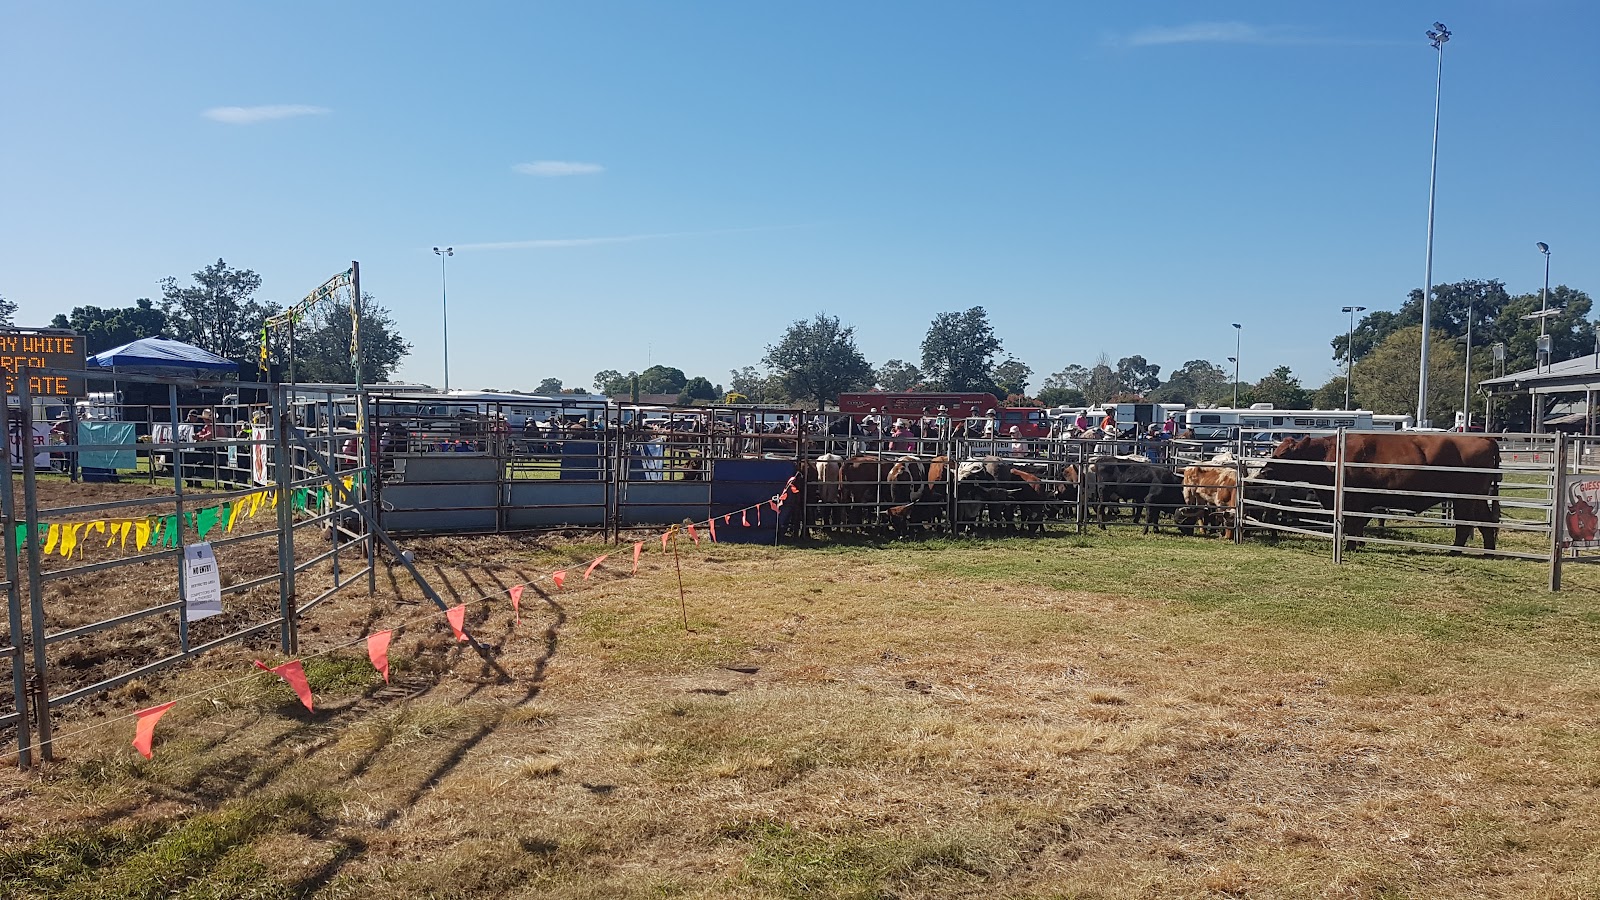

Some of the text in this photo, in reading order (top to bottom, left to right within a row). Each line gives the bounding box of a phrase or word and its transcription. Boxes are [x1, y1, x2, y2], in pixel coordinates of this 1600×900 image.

[23, 336, 74, 354] WHITE
[1580, 481, 1600, 492] GUESS
[193, 565, 211, 575] NO ENTRY
